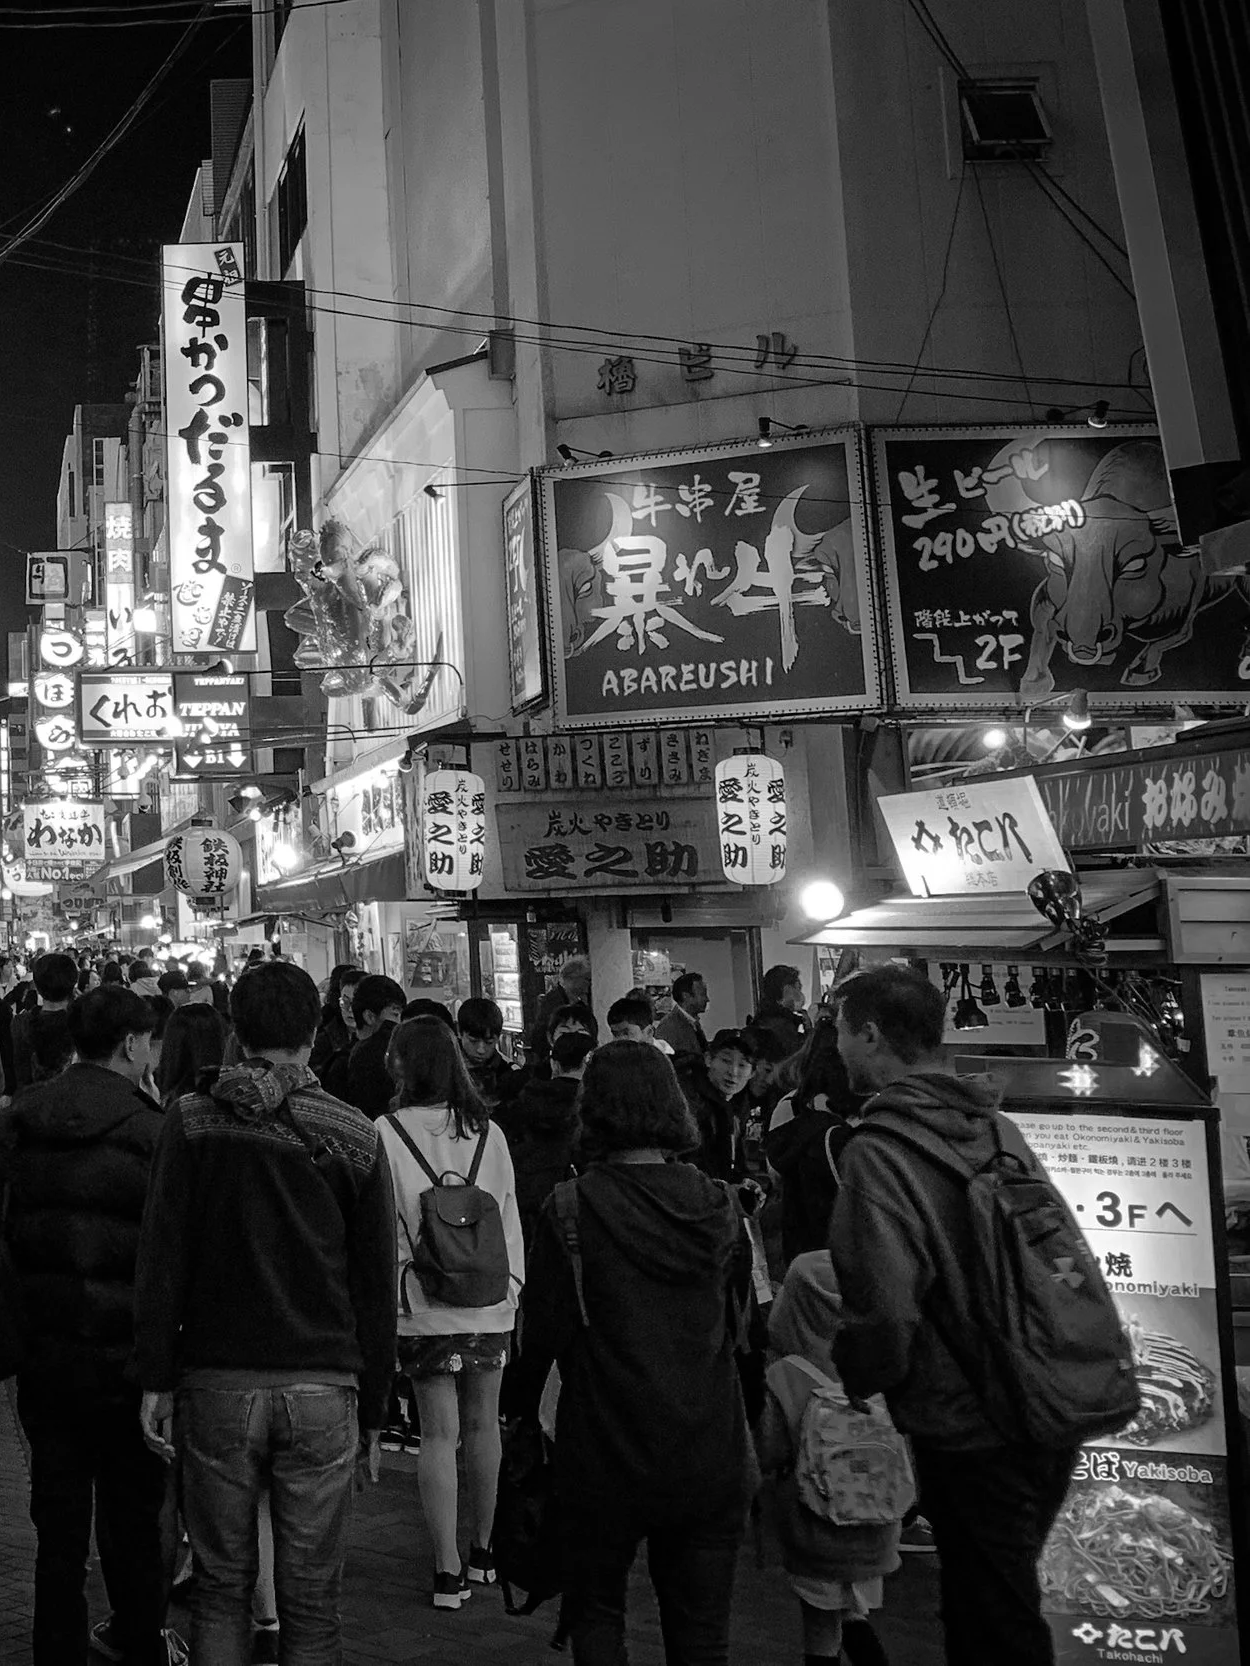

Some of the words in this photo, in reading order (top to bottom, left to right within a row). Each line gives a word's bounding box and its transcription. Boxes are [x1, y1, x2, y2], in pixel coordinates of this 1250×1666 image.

[215, 249, 239, 287] 元祖
[179, 272, 244, 576] 串かつだるま
[631, 471, 767, 527] 牛串屋
[898, 448, 1049, 530] 生ビール
[106, 514, 133, 572] 焼肉
[581, 526, 832, 675] 暴れ牛
[914, 609, 1019, 628] 階段上がって
[974, 633, 1024, 670] 2F
[193, 678, 245, 686] TEPPANYAKI
[602, 656, 774, 697] ABAREUSHI
[89, 685, 173, 729] くれお
[179, 702, 247, 717] TEPPAN
[205, 749, 225, 764] B1
[498, 744, 514, 789] せせり
[524, 741, 541, 787] はらみ
[552, 743, 568, 784] かわ
[580, 739, 598, 785] つくね
[608, 738, 627, 785] こころ
[637, 738, 652, 781] ずり
[667, 735, 682, 782] ささみ
[454, 778, 468, 855] 炭火やきとり
[544, 809, 671, 838] 炭火やきとり
[718, 778, 748, 869] 愛之助
[743, 763, 762, 846] 炭火やきとり
[27, 818, 102, 849] わなか
[426, 791, 453, 876] 愛之助
[947, 811, 1033, 865] たこ八
[41, 866, 70, 881] No.1
[524, 841, 700, 881] 愛之助
[1029, 1142, 1070, 1151] ppanyaki
[1035, 1133, 1051, 1141] you
[1073, 1133, 1133, 1147] Okonomiyaki
[1143, 1136, 1185, 1146] Yakisoba
[1079, 1124, 1094, 1133] the
[1097, 1126, 1130, 1134] second
[1139, 1127, 1160, 1135] third
[1163, 1127, 1184, 1136] floor
[1106, 1281, 1199, 1297] onomiyaki
[1123, 1461, 1213, 1483] Yakisoba
[1096, 1648, 1163, 1664] Takohachi
[1107, 1622, 1187, 1654] たこ八
